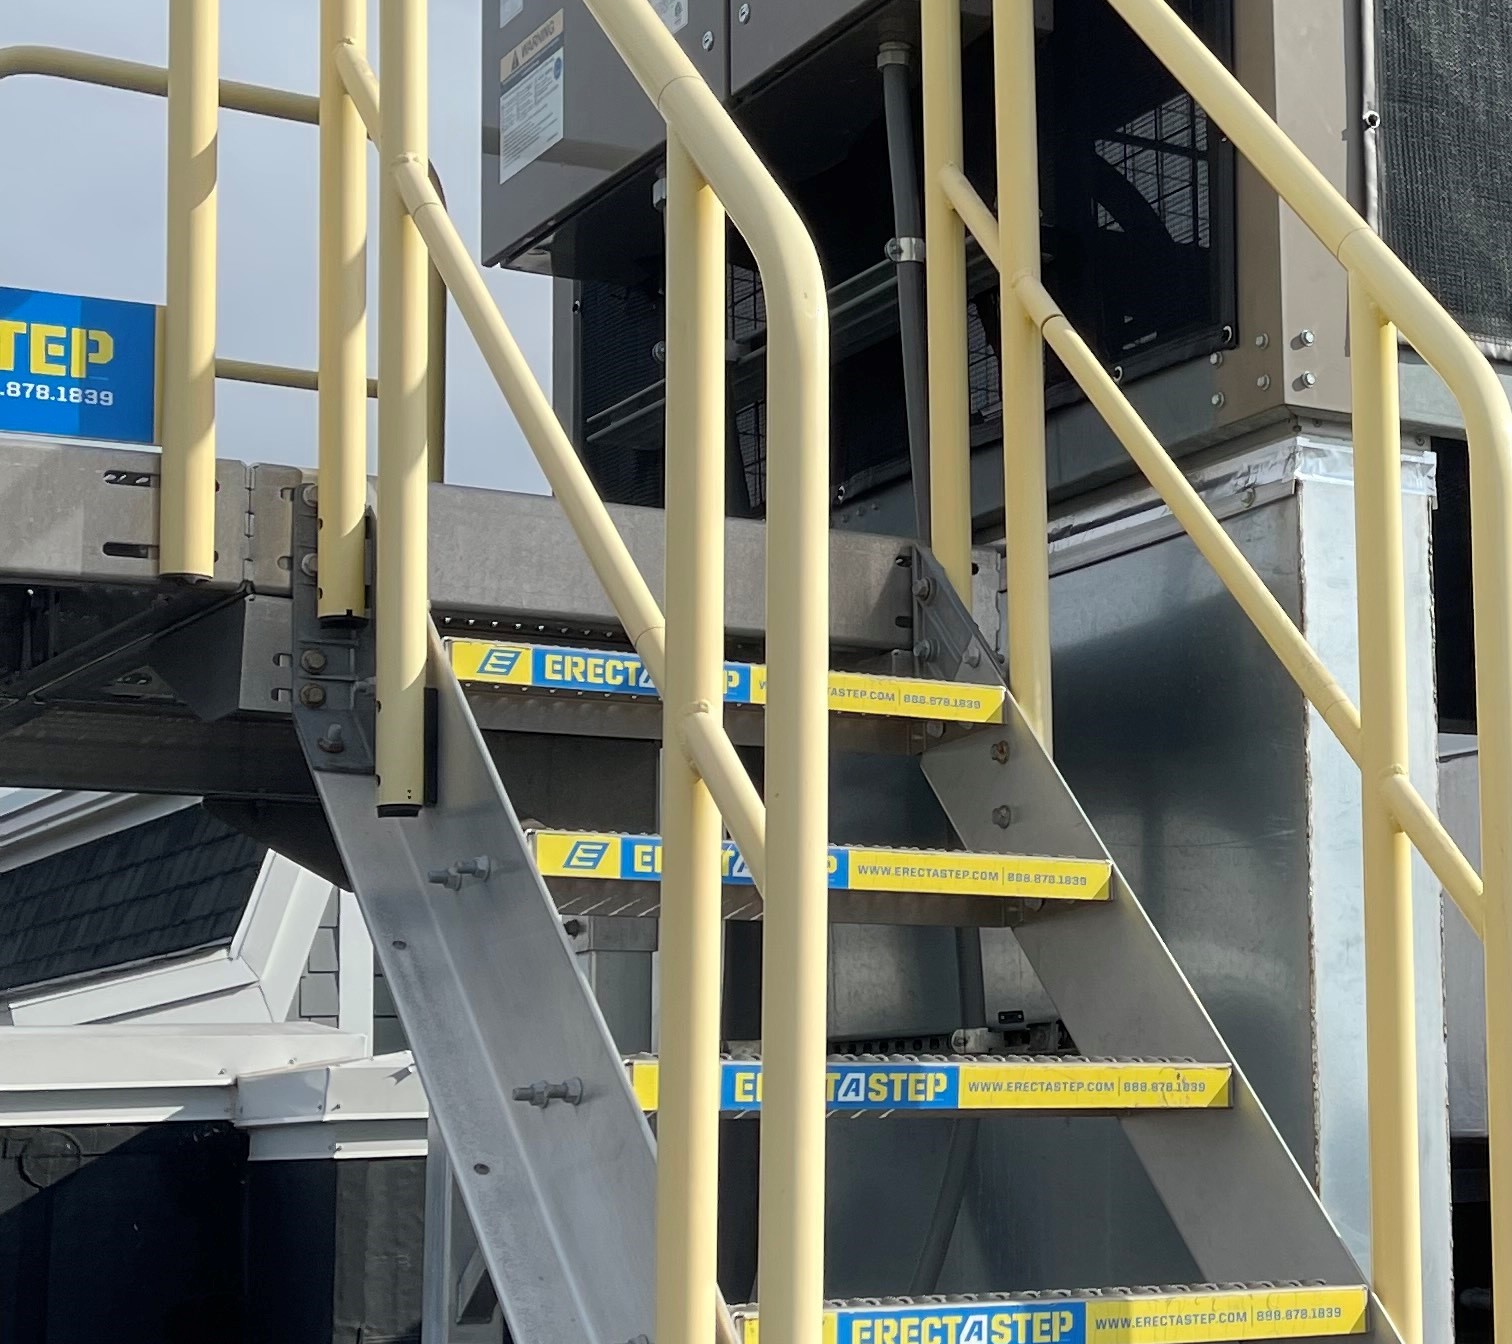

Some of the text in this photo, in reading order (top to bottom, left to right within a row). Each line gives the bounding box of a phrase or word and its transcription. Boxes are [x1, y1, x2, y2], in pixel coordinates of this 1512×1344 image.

[520, 19, 555, 58] WARNING
[857, 864, 999, 882] WWW.ERECTASTEP.COM
[1007, 872, 1088, 886] 888.878.1839
[968, 1080, 1115, 1093] WWW.ERECTASTEP.COM
[1123, 1080, 1206, 1093] 888.878.1839
[1095, 1311, 1247, 1330] WWW.ERECTASTEP.COM
[1256, 1307, 1342, 1322] 888.878.1839
